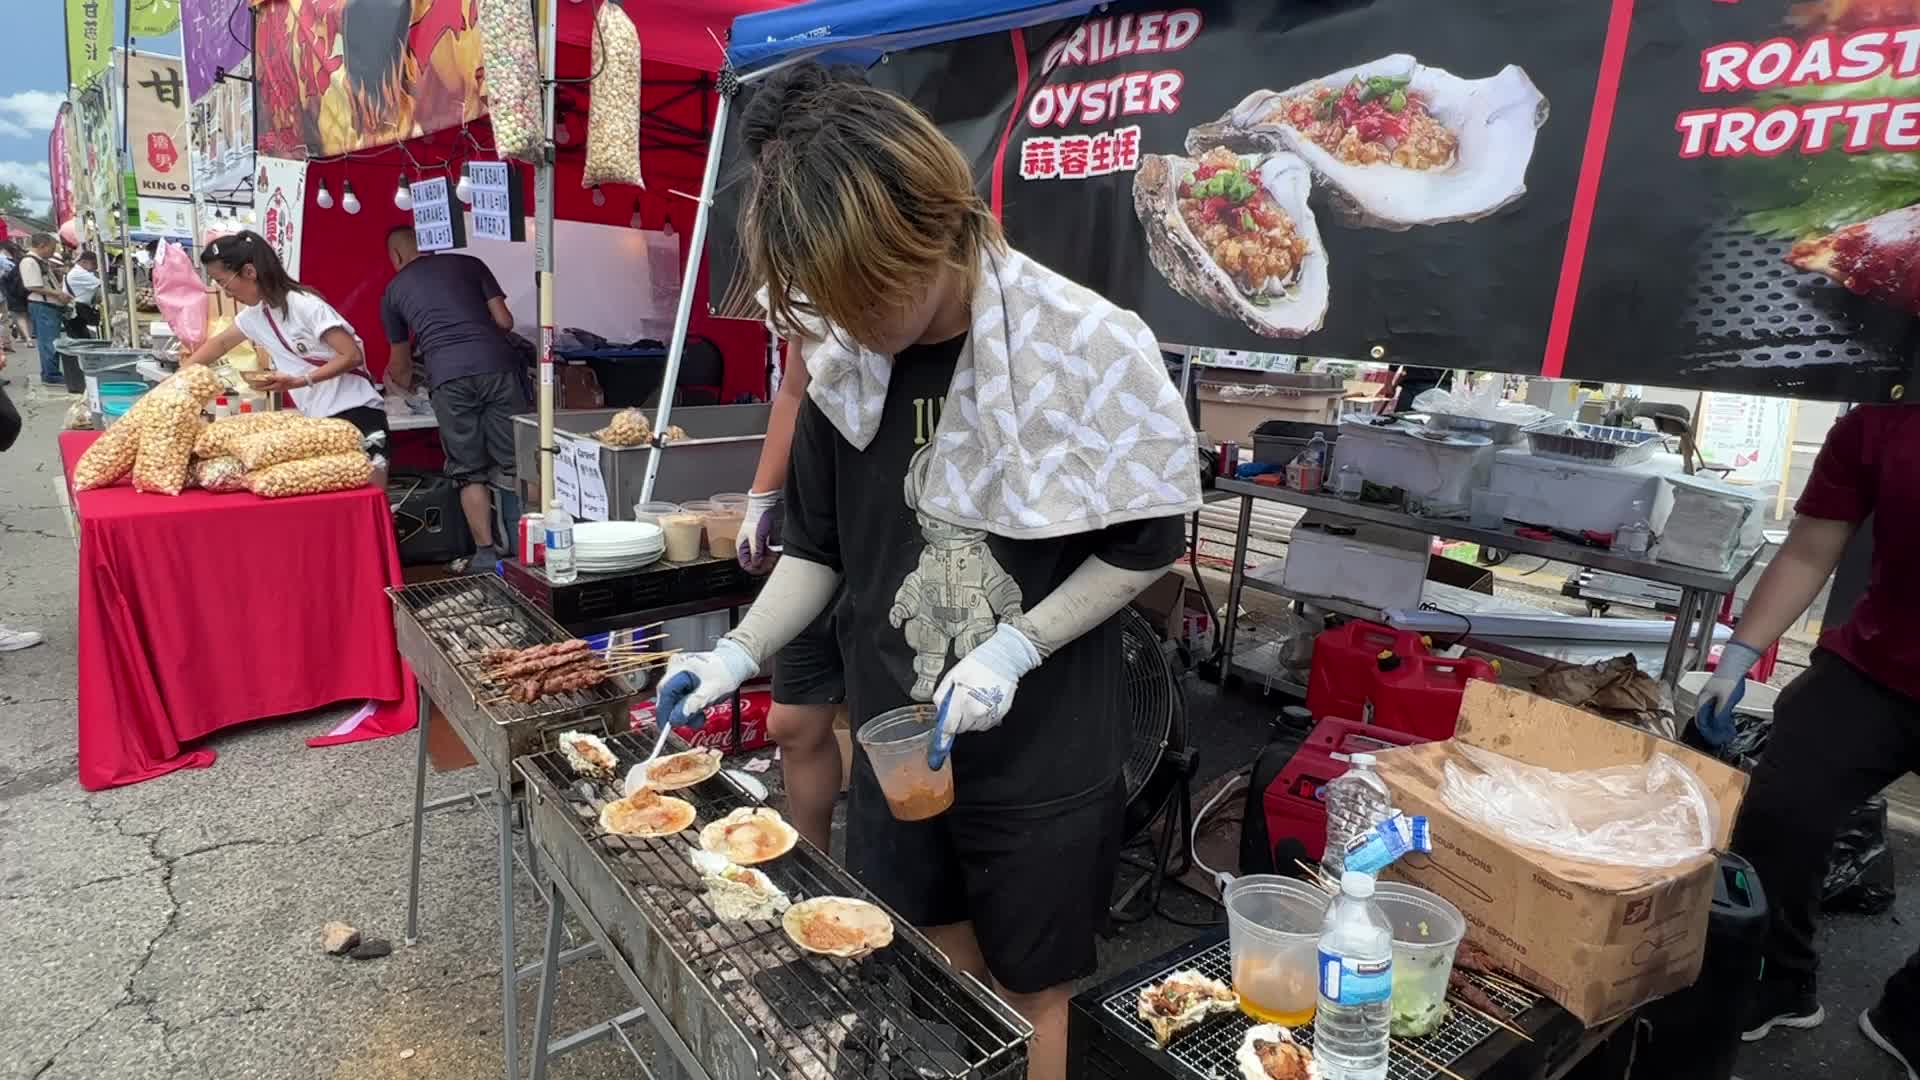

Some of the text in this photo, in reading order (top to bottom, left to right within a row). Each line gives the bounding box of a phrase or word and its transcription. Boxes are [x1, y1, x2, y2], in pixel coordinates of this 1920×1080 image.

[1027, 69, 1184, 128] OYSTER
[1021, 125, 1141, 180] 蒜蓉生蚝
[142, 180, 176, 192] KING
[1455, 847, 1494, 875] SPOONS
[1485, 924, 1528, 956] SPOONS
